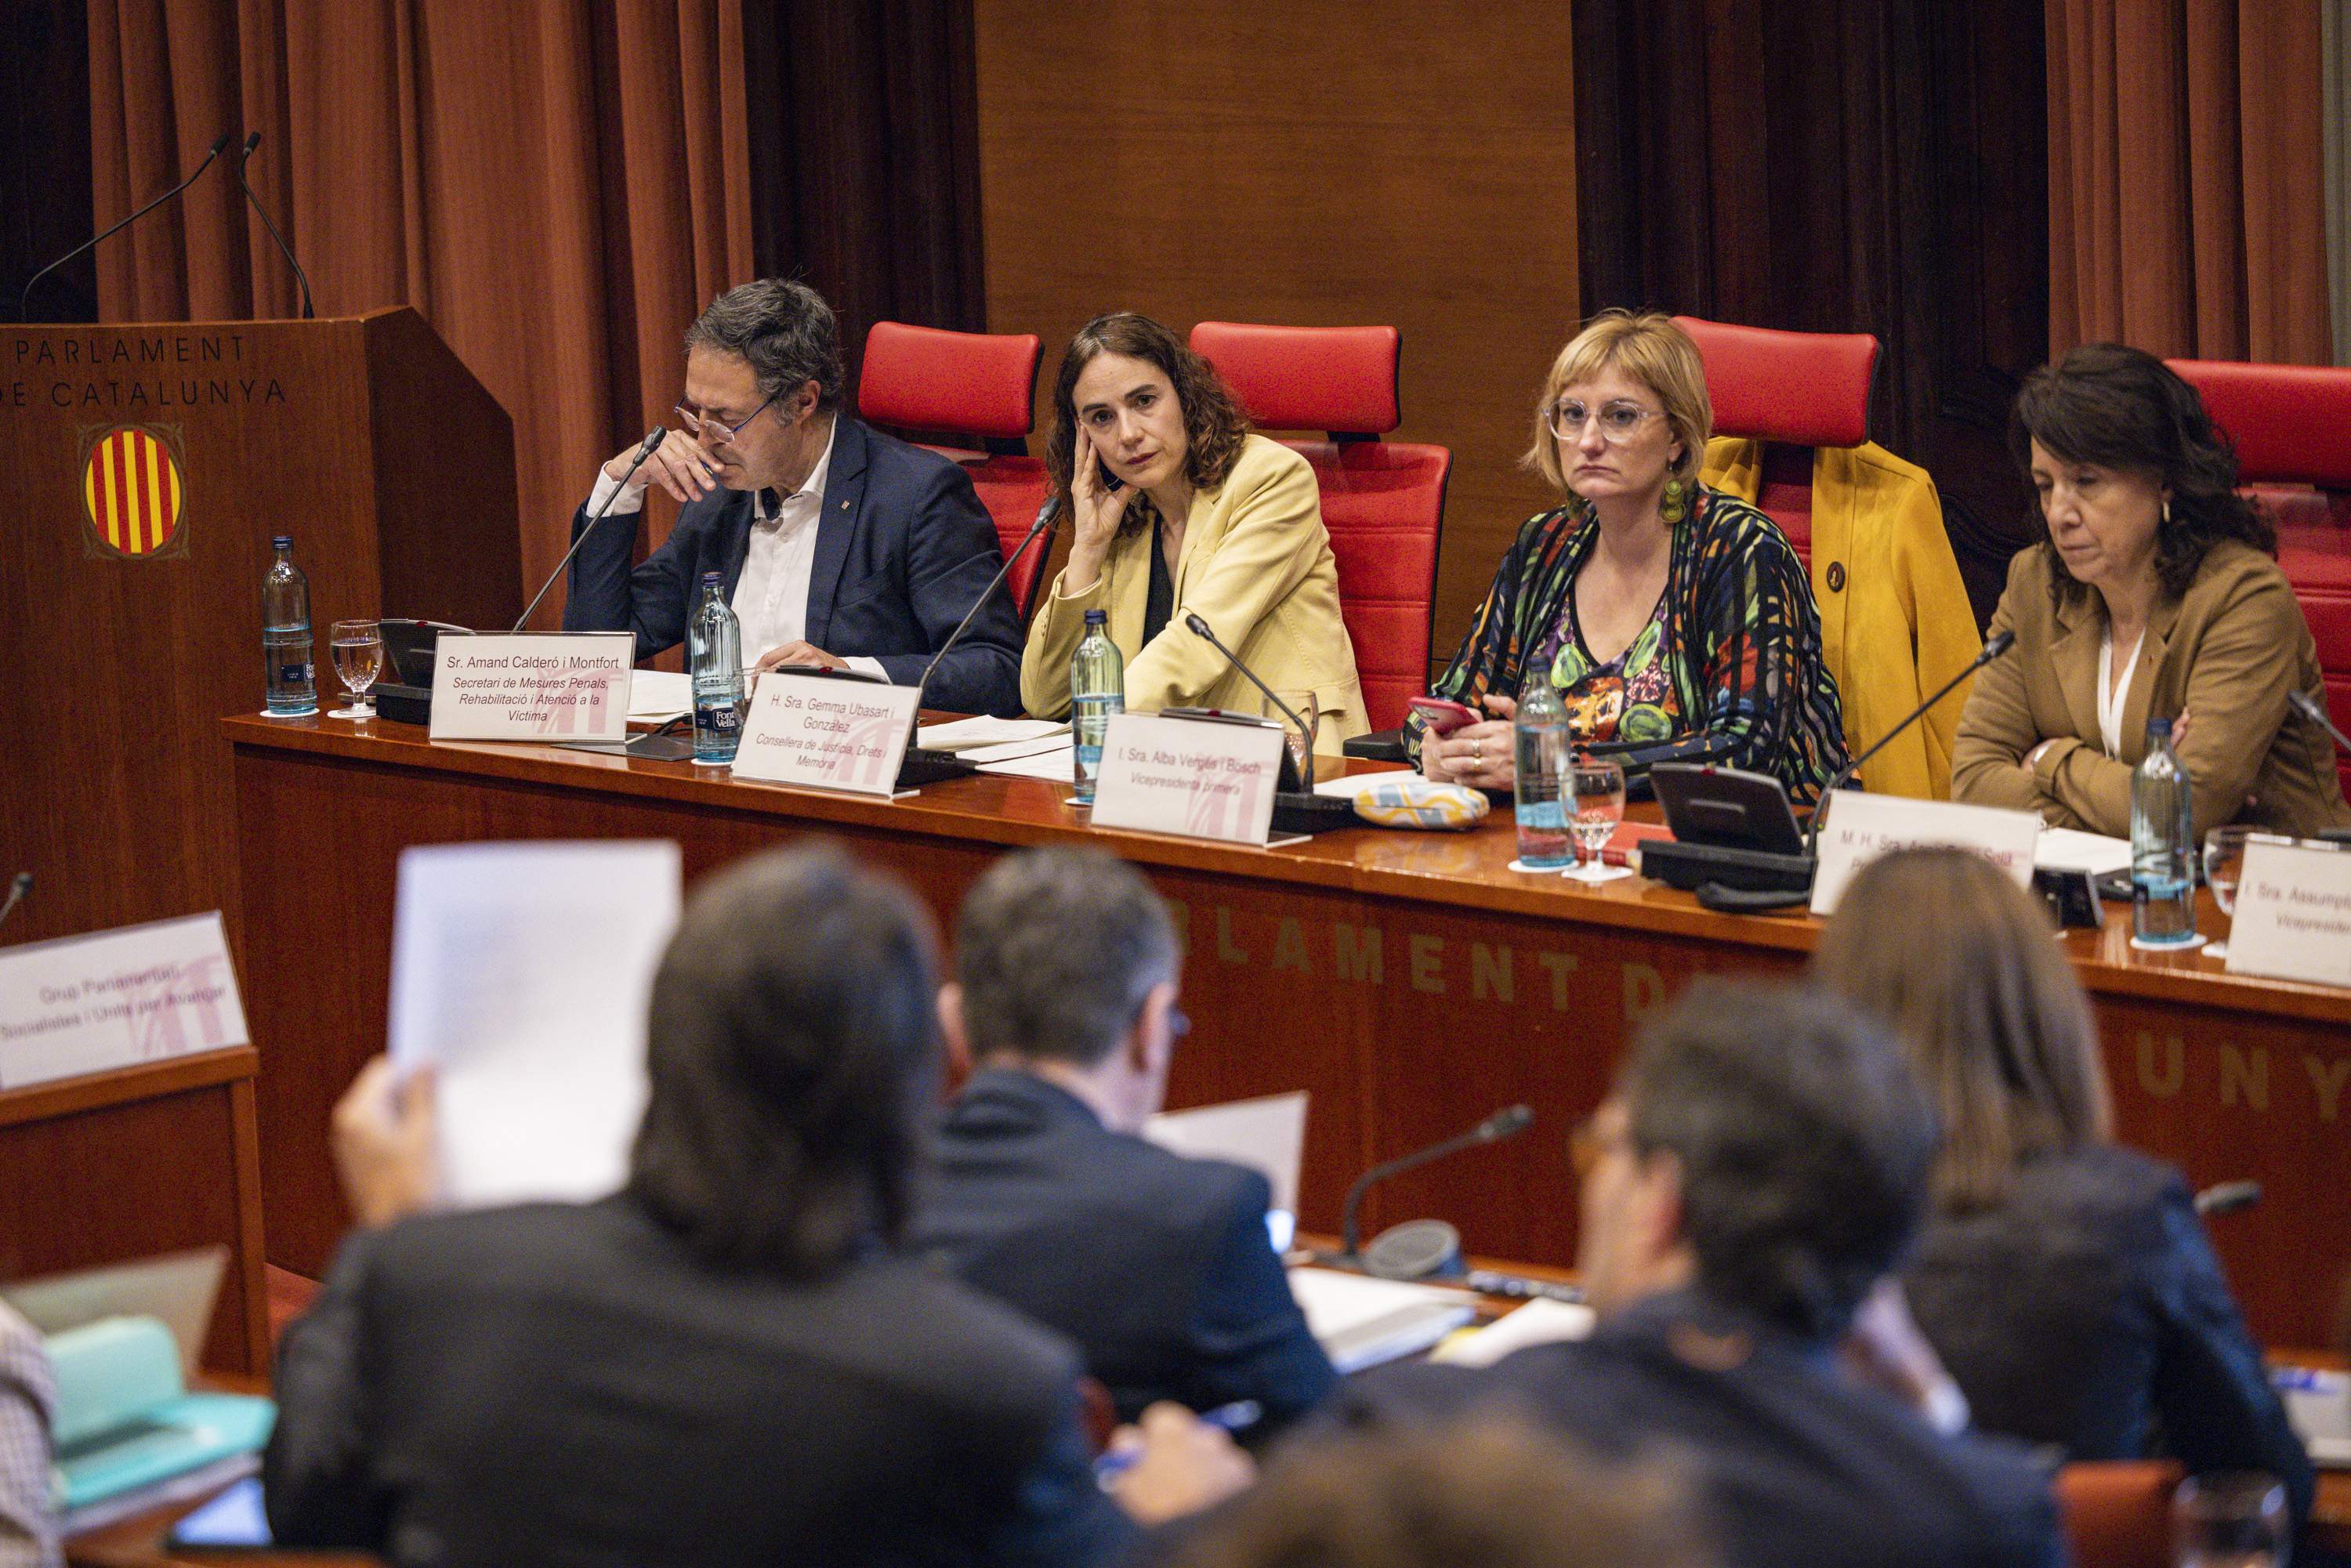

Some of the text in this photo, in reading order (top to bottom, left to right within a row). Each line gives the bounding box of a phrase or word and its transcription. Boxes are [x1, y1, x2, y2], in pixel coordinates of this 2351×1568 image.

[15, 336, 243, 364] PARLAMENT
[51, 378, 286, 407] CATALUNYA
[447, 656, 463, 668] Sr.
[467, 656, 509, 668] Amand
[513, 656, 559, 668] Calderó
[570, 657, 619, 669] Montfort
[453, 677, 608, 690] Secretari de Mesures Penals,
[459, 693, 527, 704] Rehabilitació
[530, 693, 534, 704] i
[536, 694, 577, 705] Atenció
[589, 694, 600, 704] la
[784, 695, 803, 708] Sra.
[808, 697, 846, 714] Gemma
[849, 702, 889, 719] Ubasart
[890, 706, 896, 719] i
[715, 719, 736, 728] Vella
[803, 716, 850, 733] González
[756, 733, 803, 748] Consellera
[805, 739, 817, 750] de
[857, 744, 882, 759] Drets
[1151, 750, 1176, 766] Alba
